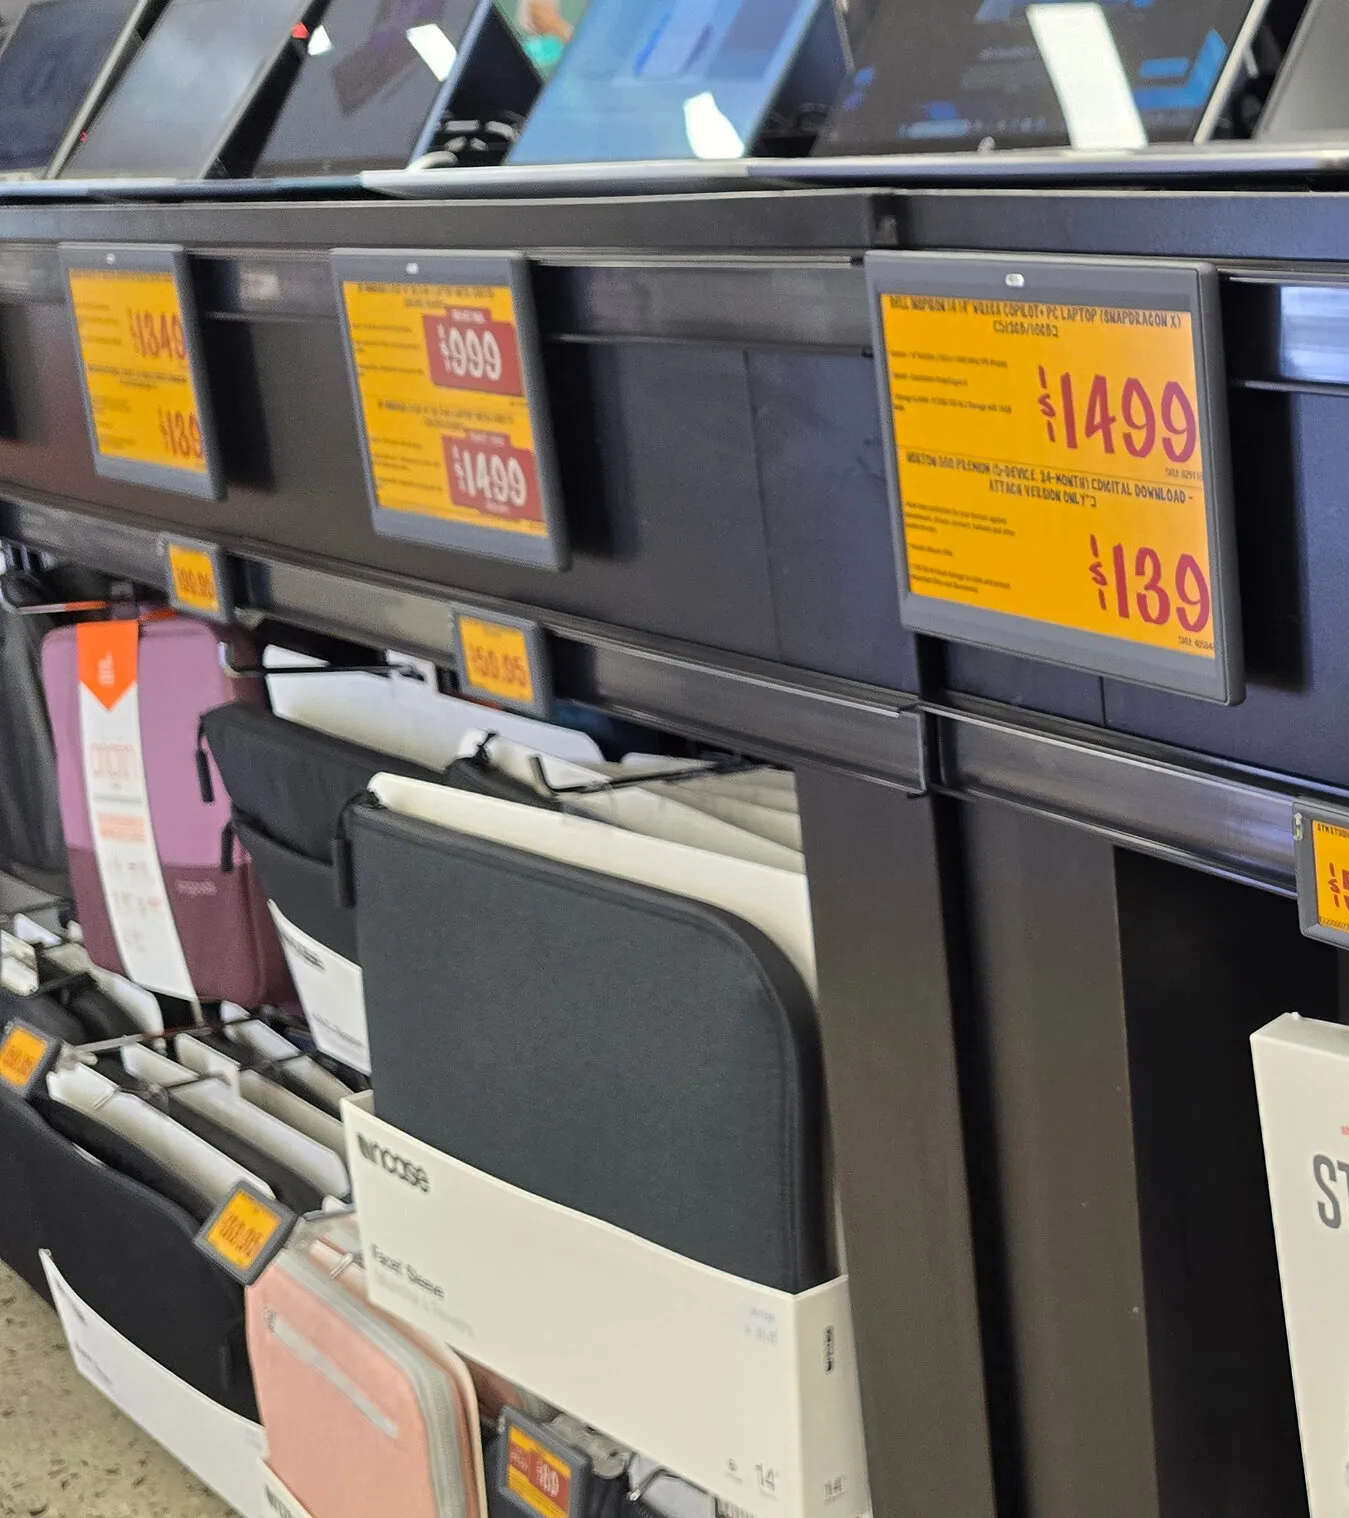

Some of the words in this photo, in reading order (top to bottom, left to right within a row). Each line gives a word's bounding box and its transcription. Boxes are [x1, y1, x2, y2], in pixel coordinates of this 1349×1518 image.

[1061, 306, 1097, 322] LAPTOP
[1100, 308, 1168, 327] (SNAPDRAGON
[1170, 314, 1182, 328] X)
[1037, 365, 1197, 463] $1499
[1134, 484, 1186, 504] DOWNLOAD
[1089, 534, 1210, 632] $139
